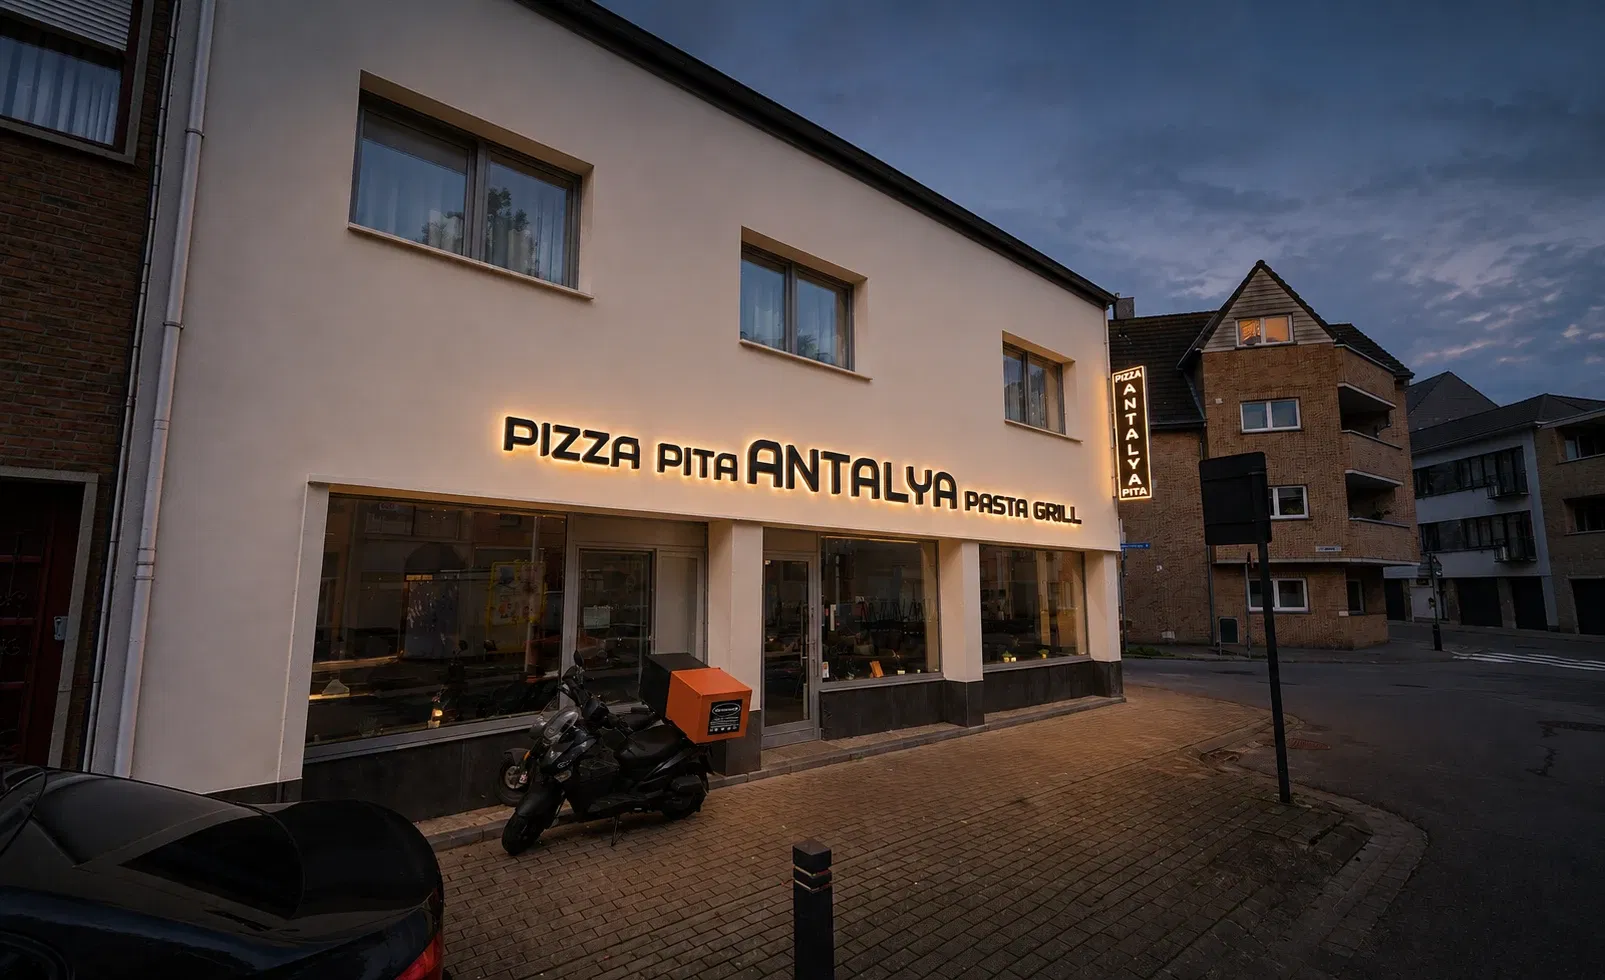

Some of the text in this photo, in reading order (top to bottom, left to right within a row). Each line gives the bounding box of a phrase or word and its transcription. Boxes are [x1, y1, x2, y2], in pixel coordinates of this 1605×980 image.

[1115, 370, 1142, 382] PIZZA
[1123, 383, 1142, 485] ANTALYA
[503, 416, 1082, 524] PIZZA PITA ANTALYA PASTA GRILL
[1122, 487, 1147, 497] PITA
